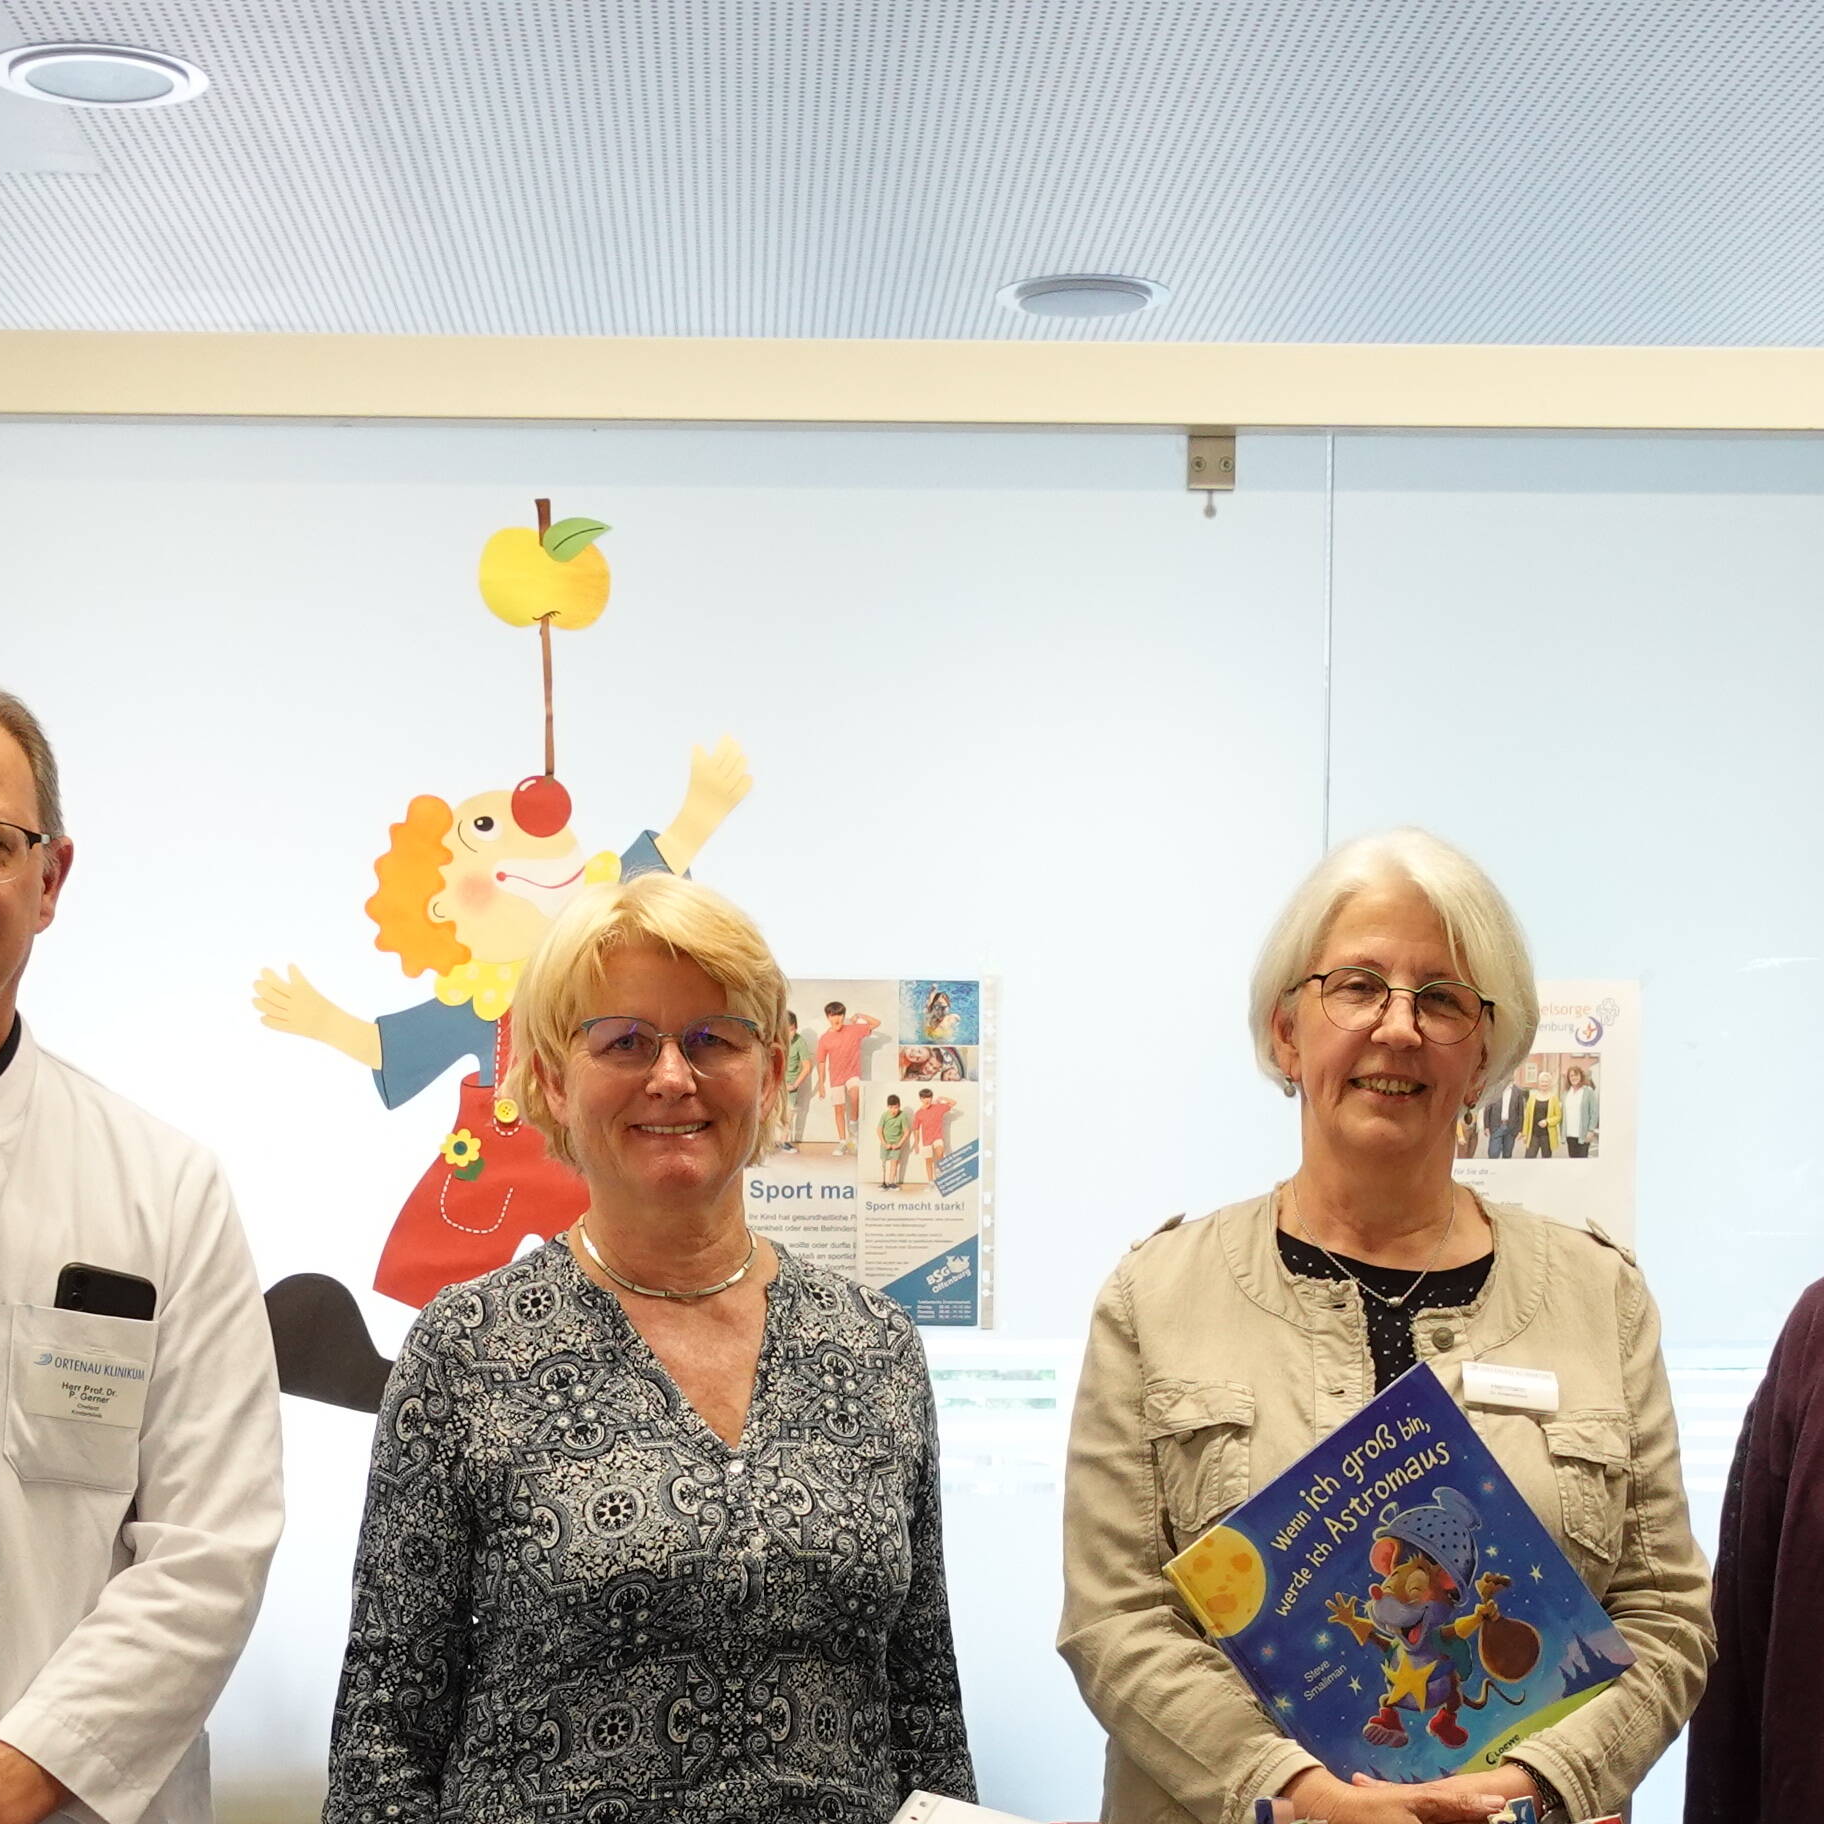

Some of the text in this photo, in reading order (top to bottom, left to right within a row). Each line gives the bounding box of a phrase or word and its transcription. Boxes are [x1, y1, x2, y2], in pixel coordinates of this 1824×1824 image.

[750, 1180, 813, 1203] Sport
[865, 1201, 965, 1212] Sport macht stark!
[926, 1266, 951, 1285] BSG
[55, 1357, 144, 1380] ORTENAU KLINIKUM
[1270, 1413, 1432, 1554] Wenn ich groß bin,
[1275, 1440, 1451, 1618] werde ich Astromaus
[1303, 1662, 1348, 1702] Smallman
[1304, 1658, 1331, 1683] Steve
